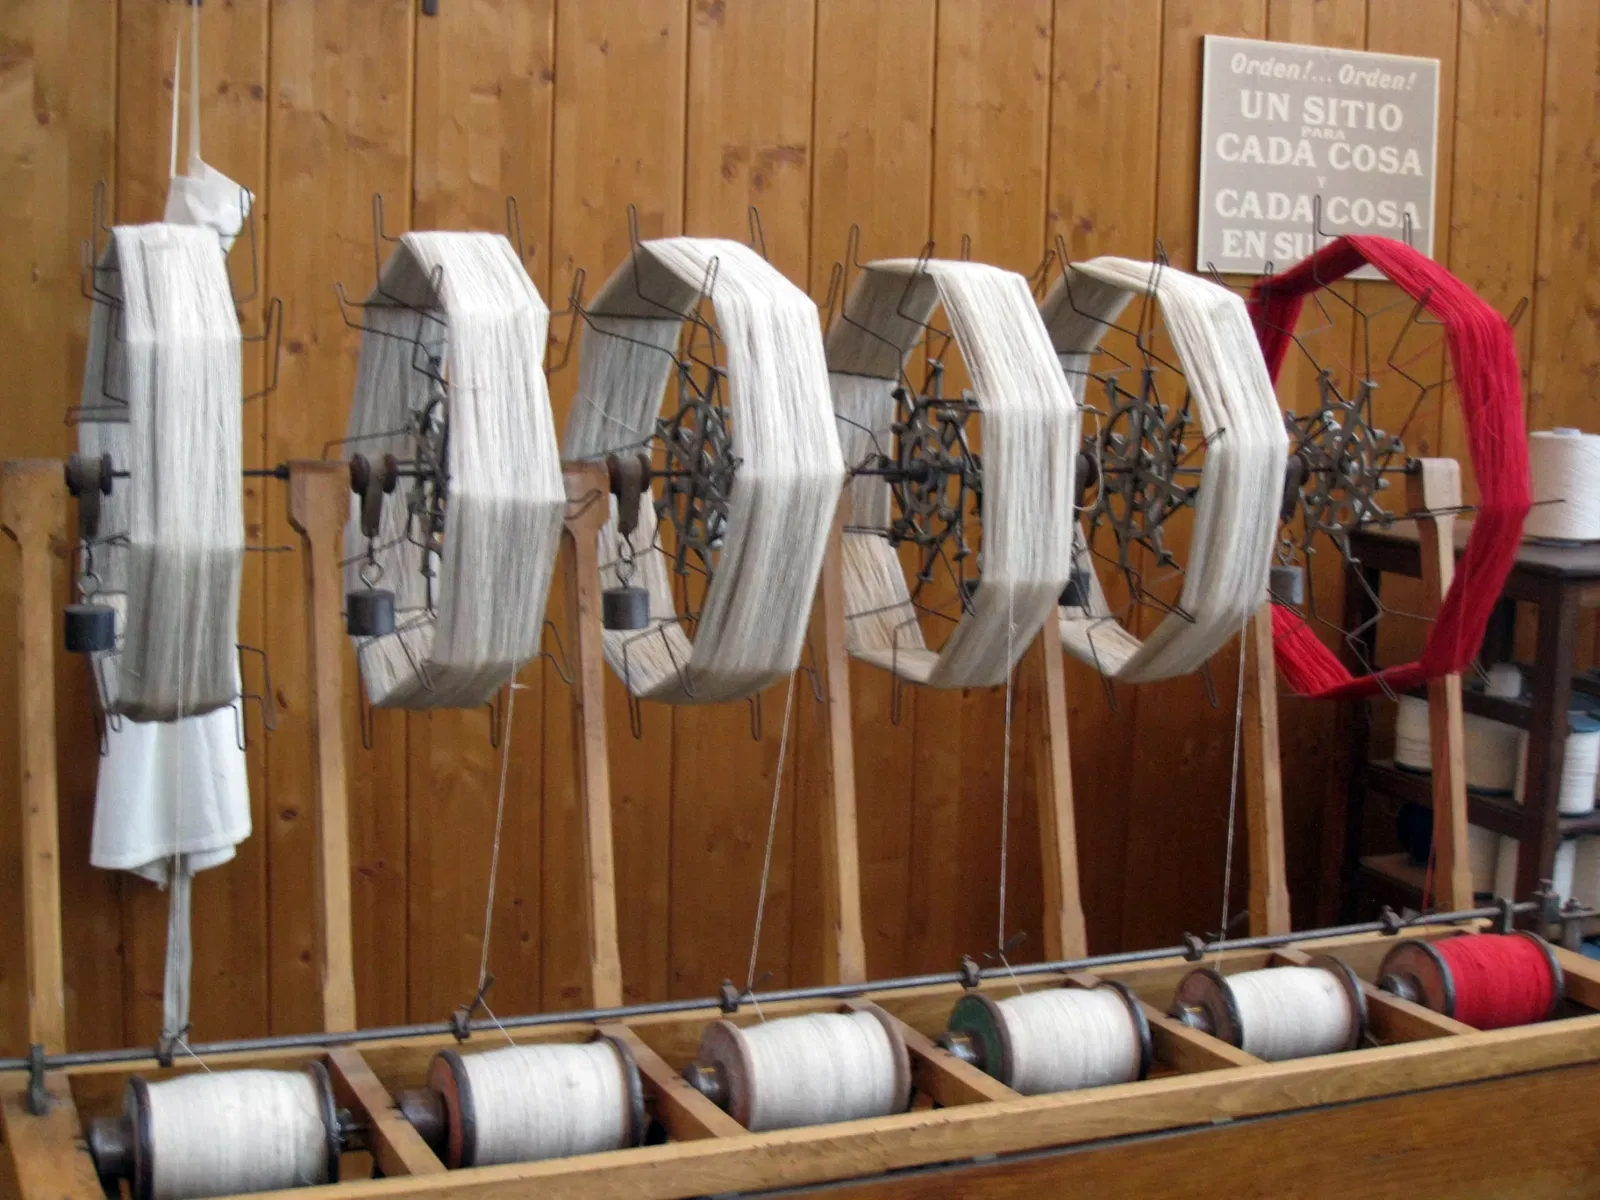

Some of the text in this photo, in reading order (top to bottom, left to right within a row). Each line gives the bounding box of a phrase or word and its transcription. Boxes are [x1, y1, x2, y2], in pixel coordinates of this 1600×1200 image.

[1338, 64, 1417, 91] Orden!
[1240, 89, 1403, 132] UN SITIO
[1301, 125, 1346, 141] PARA
[1216, 132, 1423, 176] CADA COSA
[1316, 176, 1327, 188] Y
[1215, 188, 1422, 229] CADA COSA
[1220, 228, 1315, 261] EN SU
